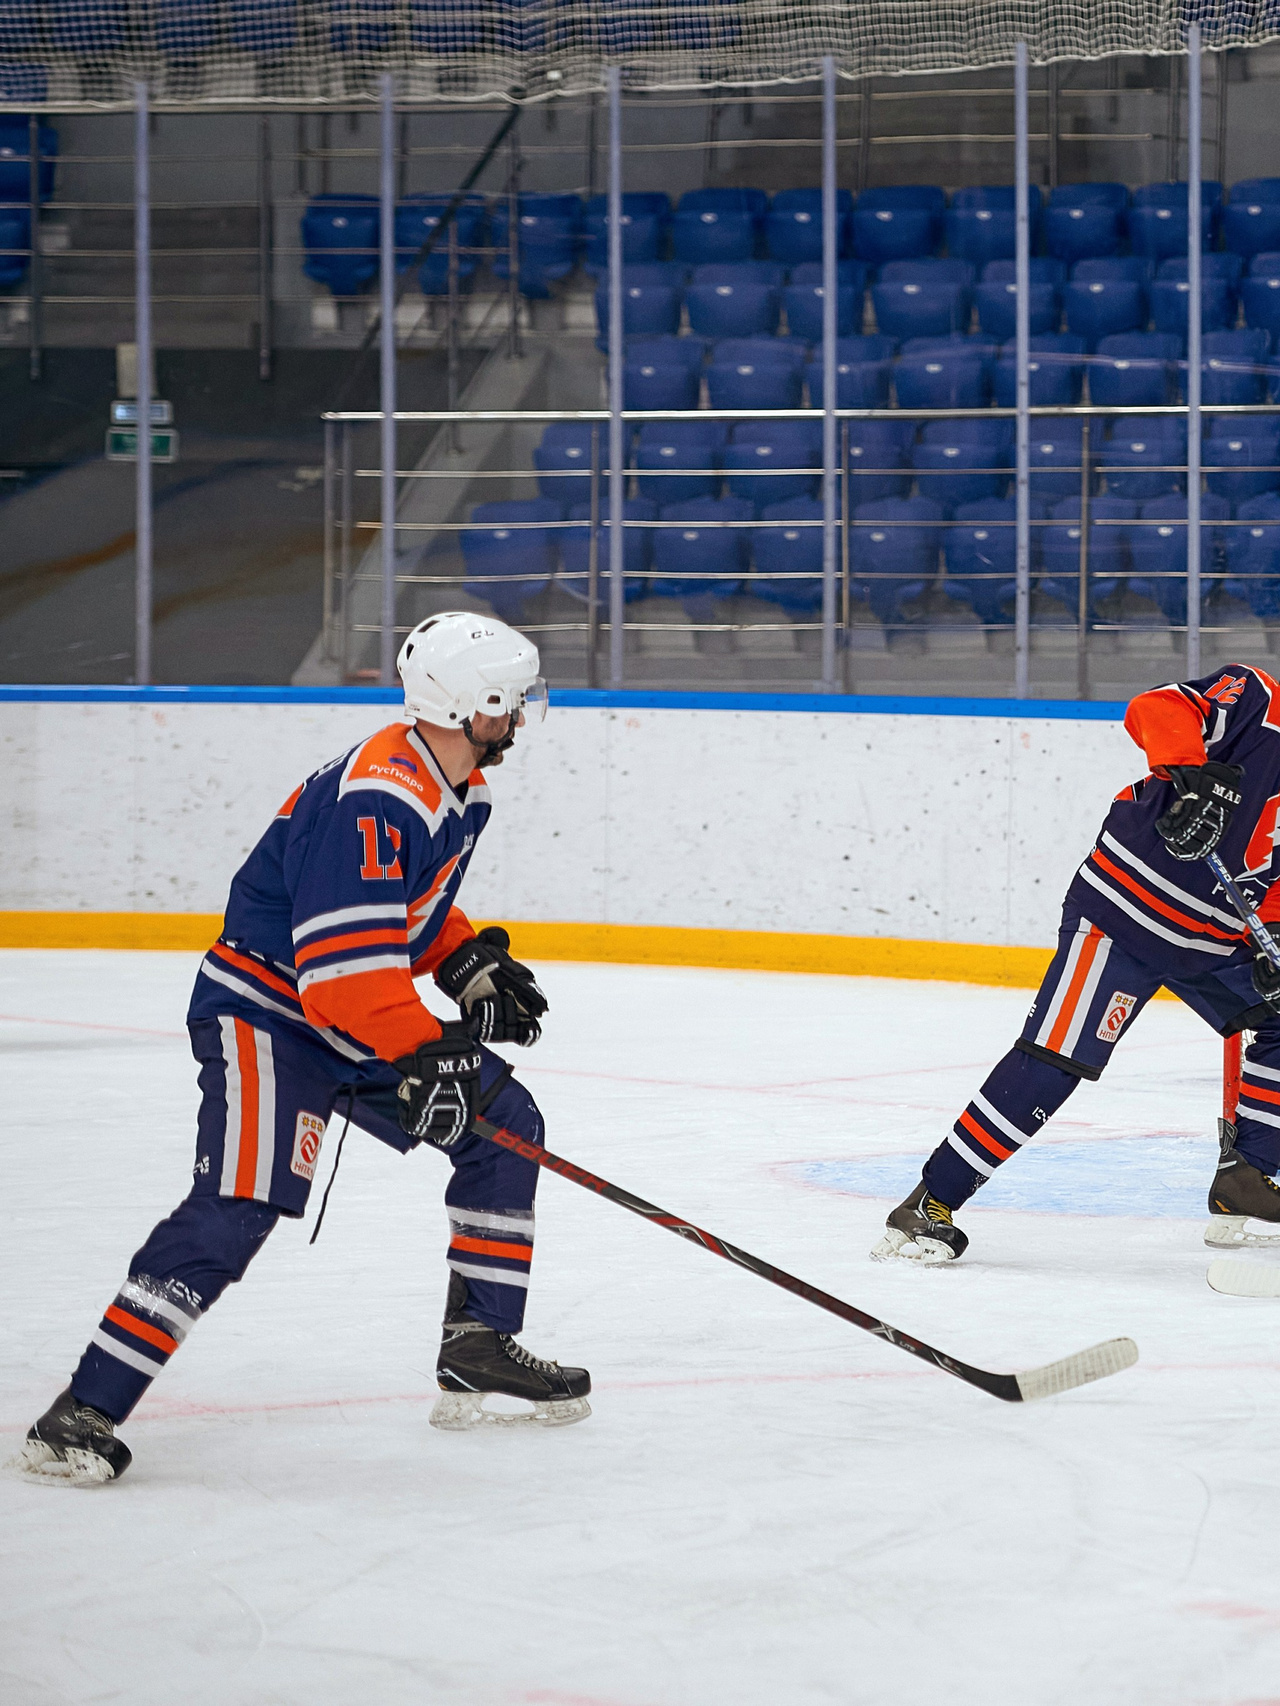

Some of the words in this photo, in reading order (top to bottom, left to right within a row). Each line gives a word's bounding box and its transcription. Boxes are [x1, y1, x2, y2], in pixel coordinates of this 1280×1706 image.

[1203, 673, 1247, 705] 12
[368, 763, 425, 793] РусГидро
[491, 1128, 611, 1193] BAUER
